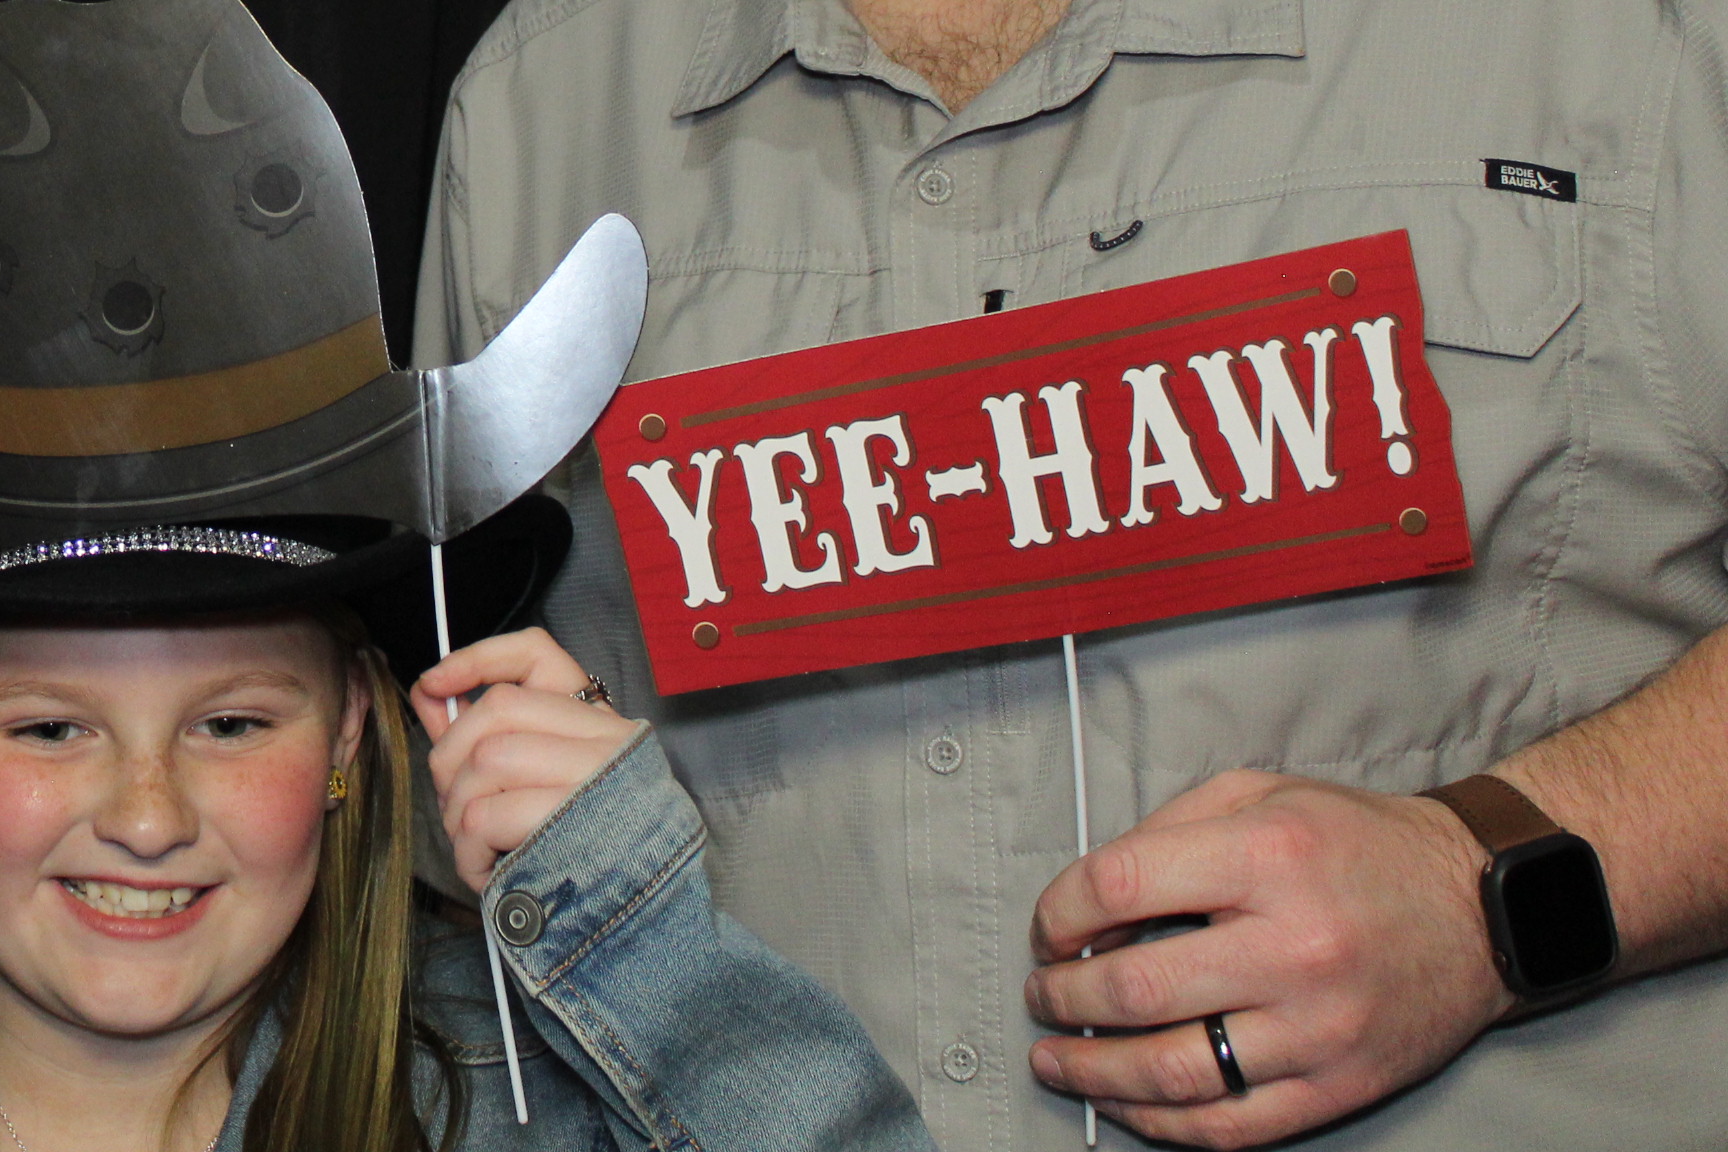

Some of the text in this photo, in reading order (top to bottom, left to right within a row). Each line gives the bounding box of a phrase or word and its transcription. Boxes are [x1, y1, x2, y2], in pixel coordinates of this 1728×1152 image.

[1500, 165, 1535, 179] EDDIE
[1500, 175, 1538, 189] BAUER
[627, 315, 1417, 609] YEE-HAW!
